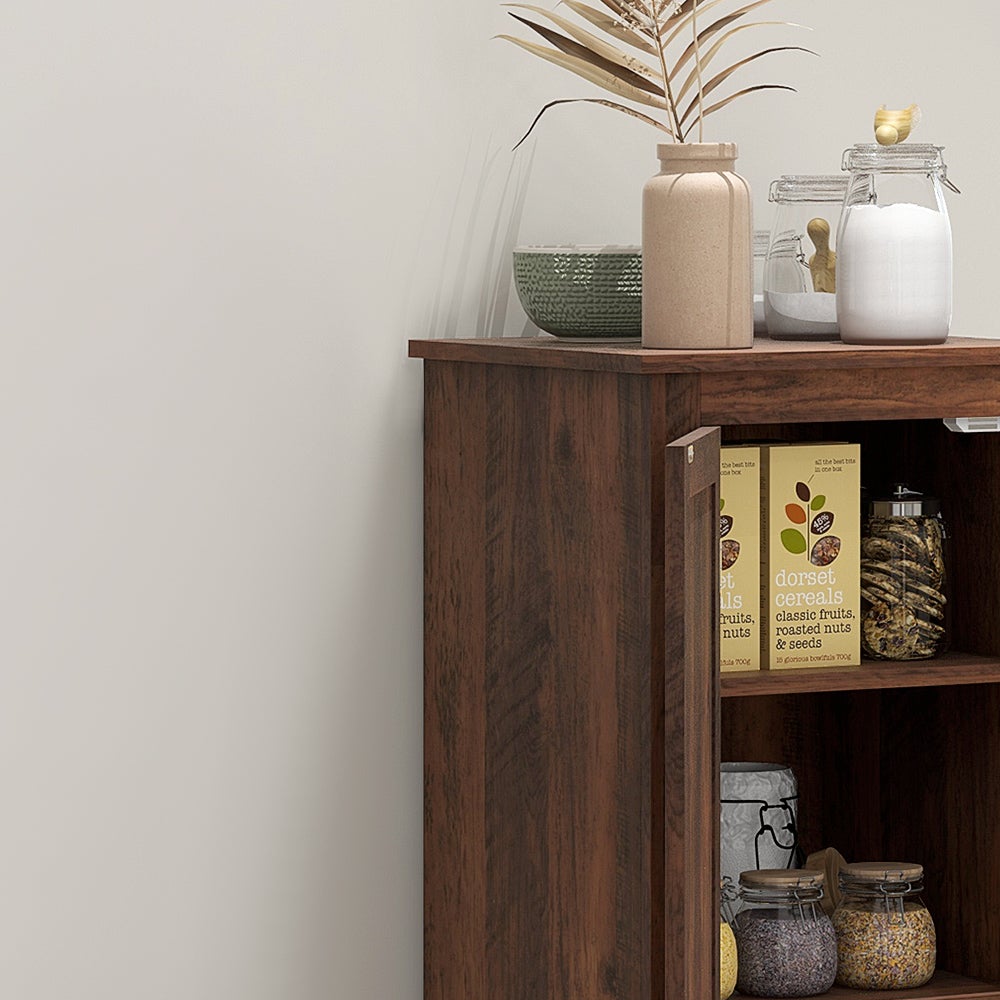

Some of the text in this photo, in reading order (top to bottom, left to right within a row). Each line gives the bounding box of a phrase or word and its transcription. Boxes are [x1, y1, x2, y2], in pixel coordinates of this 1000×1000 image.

[775, 569, 836, 587] dorset
[775, 588, 843, 607] cereals
[775, 608, 856, 622] classic fruits,
[723, 627, 751, 639] nuts
[776, 622, 852, 636] roasted nuts
[776, 637, 822, 650] & seeds
